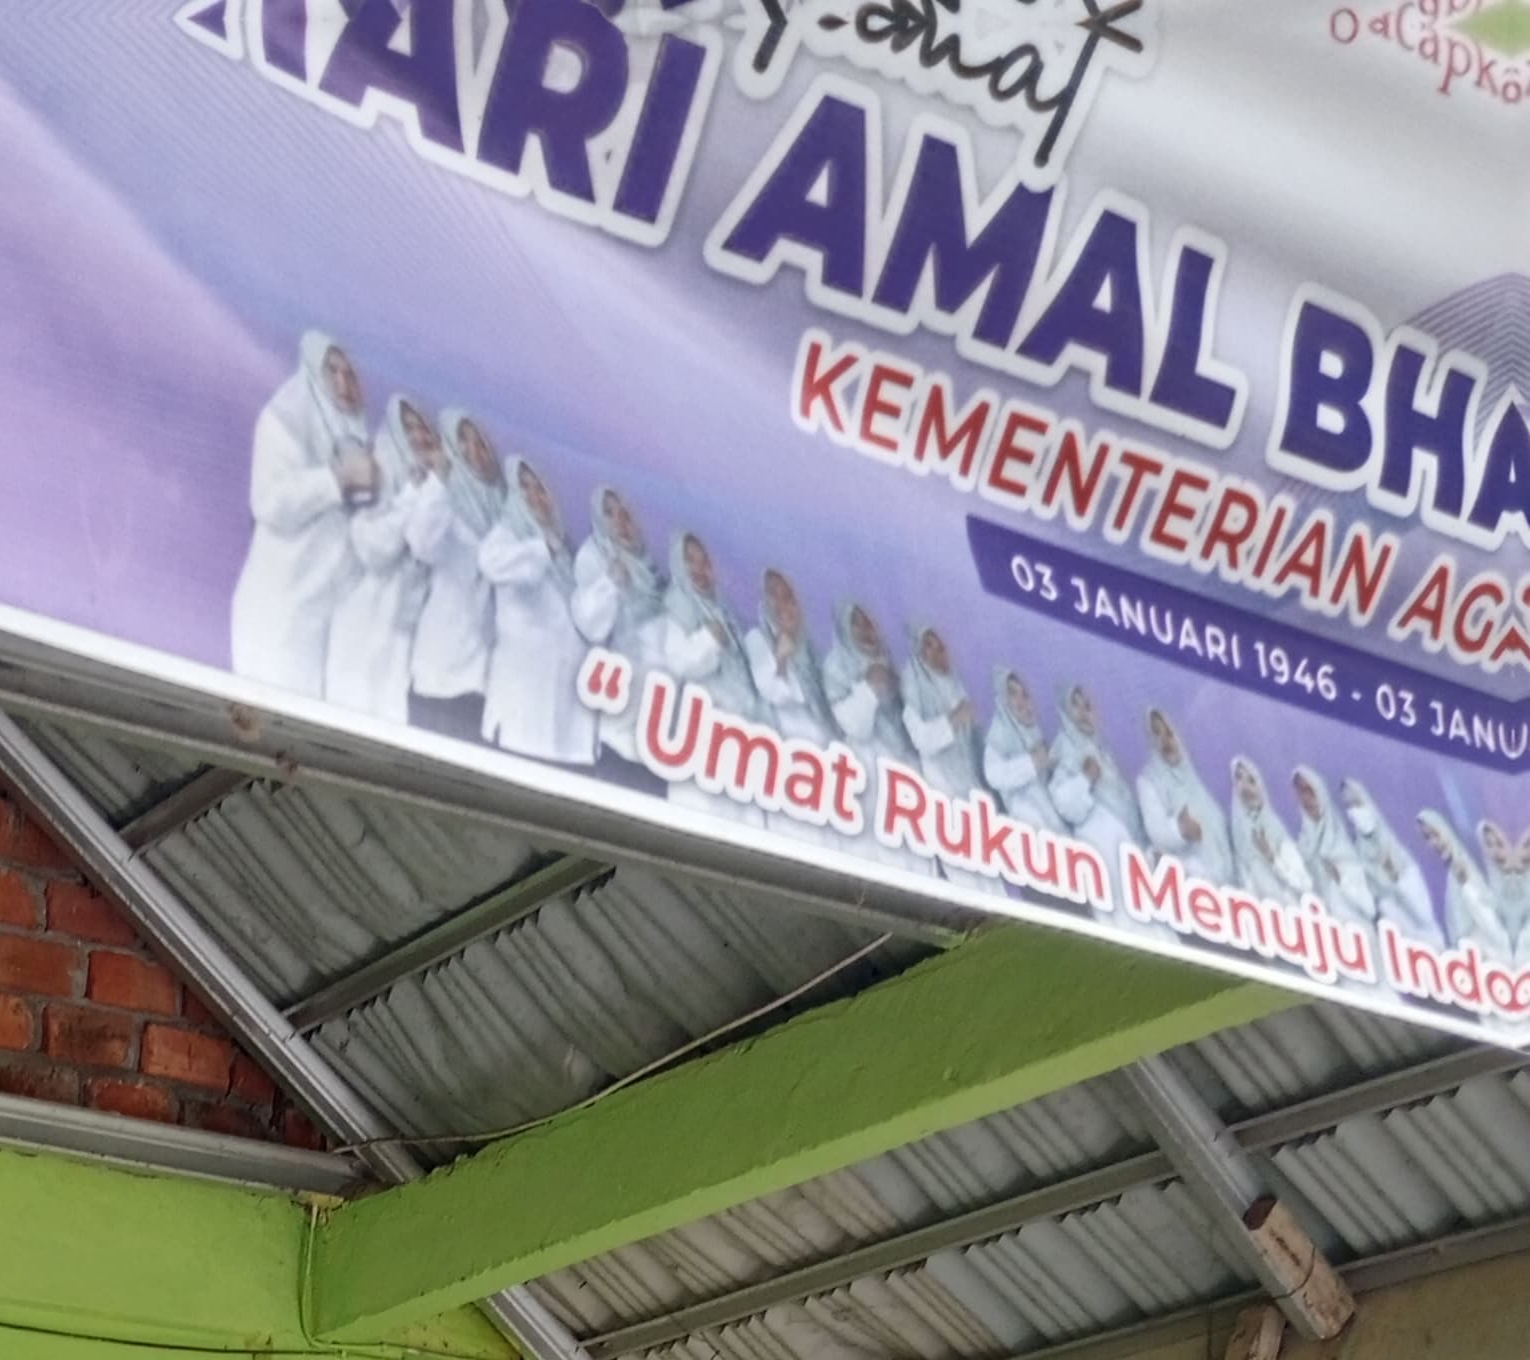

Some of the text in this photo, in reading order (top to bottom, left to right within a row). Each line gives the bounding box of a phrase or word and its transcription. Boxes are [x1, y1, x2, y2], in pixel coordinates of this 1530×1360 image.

[724, 94, 1238, 431] AMAL
[798, 340, 1393, 616] KEMENTERIAN
[1010, 552, 1060, 602] 03
[1073, 574, 1242, 671] JANUARI
[1252, 640, 1338, 702] 1946
[1375, 682, 1417, 727] 03
[884, 769, 1107, 903] Rukun
[1127, 854, 1371, 976] Menuju
